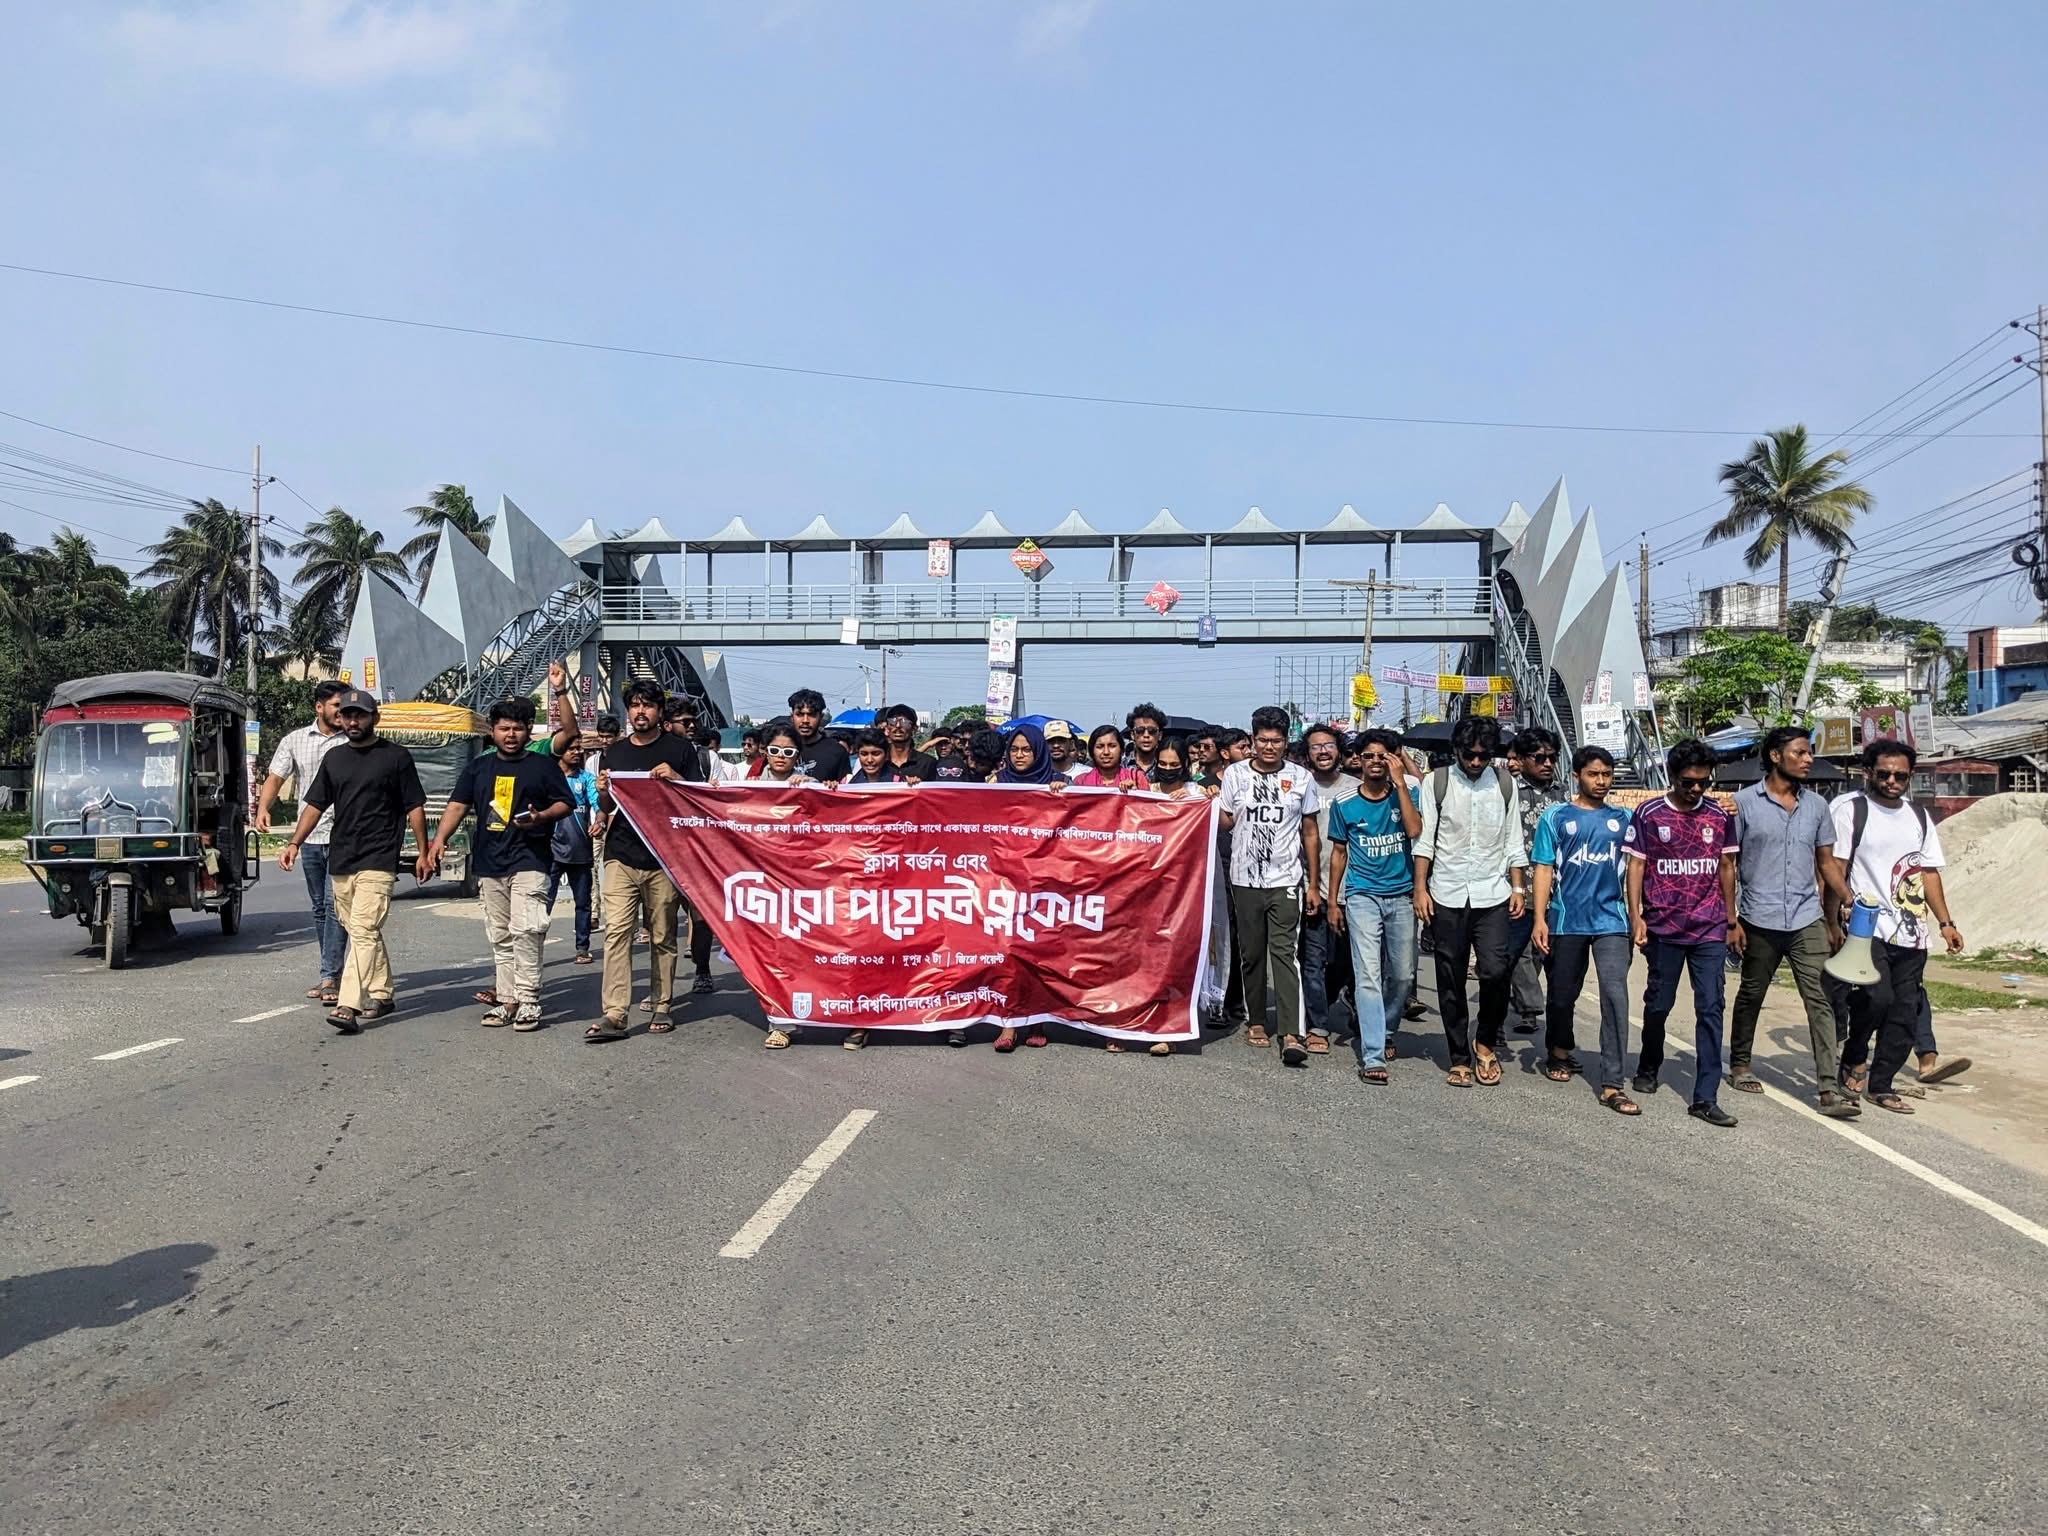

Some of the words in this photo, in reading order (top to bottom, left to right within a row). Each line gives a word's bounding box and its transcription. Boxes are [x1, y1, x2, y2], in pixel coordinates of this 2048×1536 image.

[1829, 724, 1846, 740] airtel
[1246, 805, 1284, 823] MCJ
[754, 823, 770, 833] এক
[773, 824, 790, 834] দফা
[792, 821, 811, 834] দাবি
[812, 824, 820, 834] ও
[821, 823, 853, 834] আমরণ
[854, 823, 882, 833] অনশন
[884, 821, 919, 836] কর্মসূচির
[920, 823, 942, 833] সাথে
[944, 823, 980, 834] একাত্মতা
[983, 823, 1009, 834] প্রকাশ
[1011, 825, 1029, 836] করে
[1031, 827, 1054, 840] খুলনা
[1055, 826, 1114, 842] বিশ্ববিদ্যালয়ের
[1115, 829, 1163, 844] শিক্ষার্থীদের
[864, 853, 900, 874] ক্লাস
[903, 846, 947, 872] বর্জন
[953, 853, 990, 872] এবং
[1367, 846, 1379, 857] FLY
[1656, 858, 1719, 876] CHEMISTRY
[723, 871, 835, 940] জিরো
[849, 876, 980, 940] পয়েন্ট
[983, 889, 1105, 942] ব্লকেড
[814, 955, 828, 965] ২৩
[830, 952, 857, 966] এপ্রিল
[860, 955, 884, 965] ২০২৫
[902, 954, 921, 969] দুপুর
[955, 952, 977, 965] জিরো
[980, 952, 1006, 966] পয়েন্ট
[819, 997, 854, 1016] খুলনা
[857, 993, 942, 1014] বিশ্ববিদ্যালয়ের
